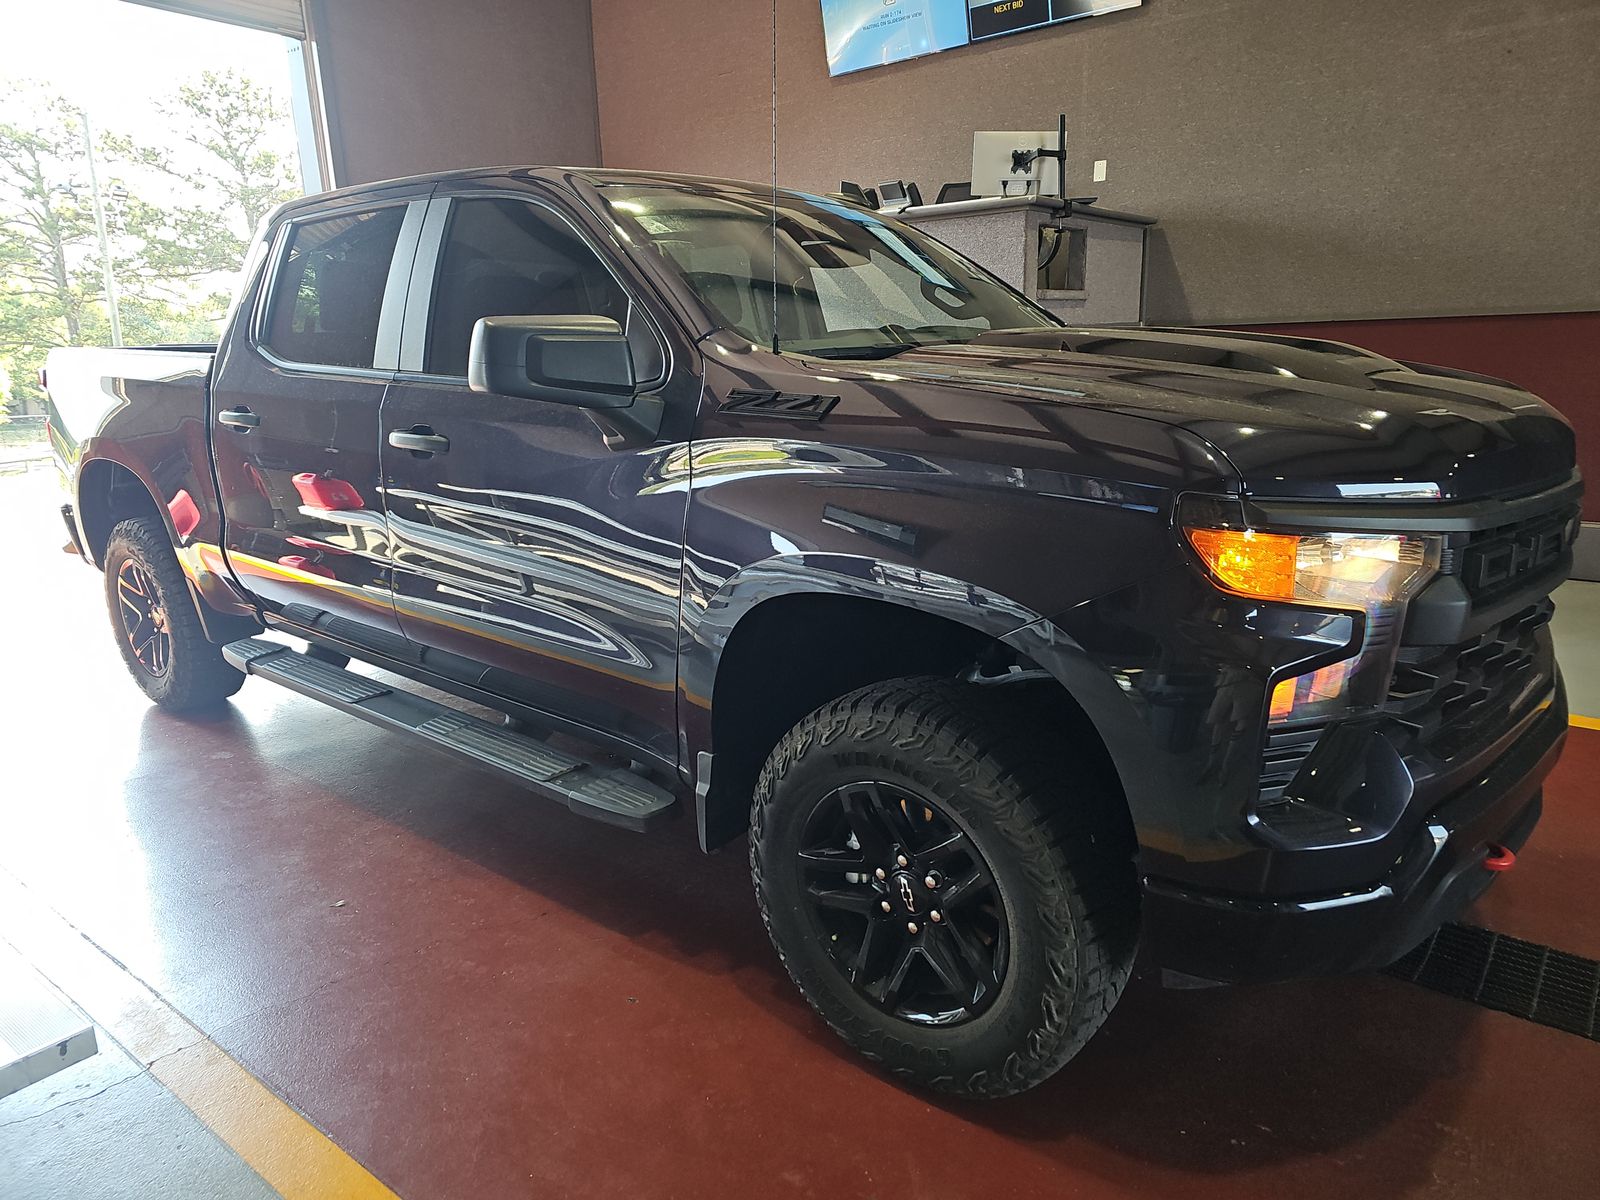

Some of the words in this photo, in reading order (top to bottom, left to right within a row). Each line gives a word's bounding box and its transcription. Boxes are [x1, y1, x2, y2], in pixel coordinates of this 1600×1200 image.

[993, 2, 1011, 14] NEXT
[1012, 0, 1024, 9] BID
[862, 22, 879, 30] WAITING
[887, 15, 910, 24] SLIDESHOW
[715, 388, 841, 421] Z71
[832, 751, 981, 830] WRANGLER
